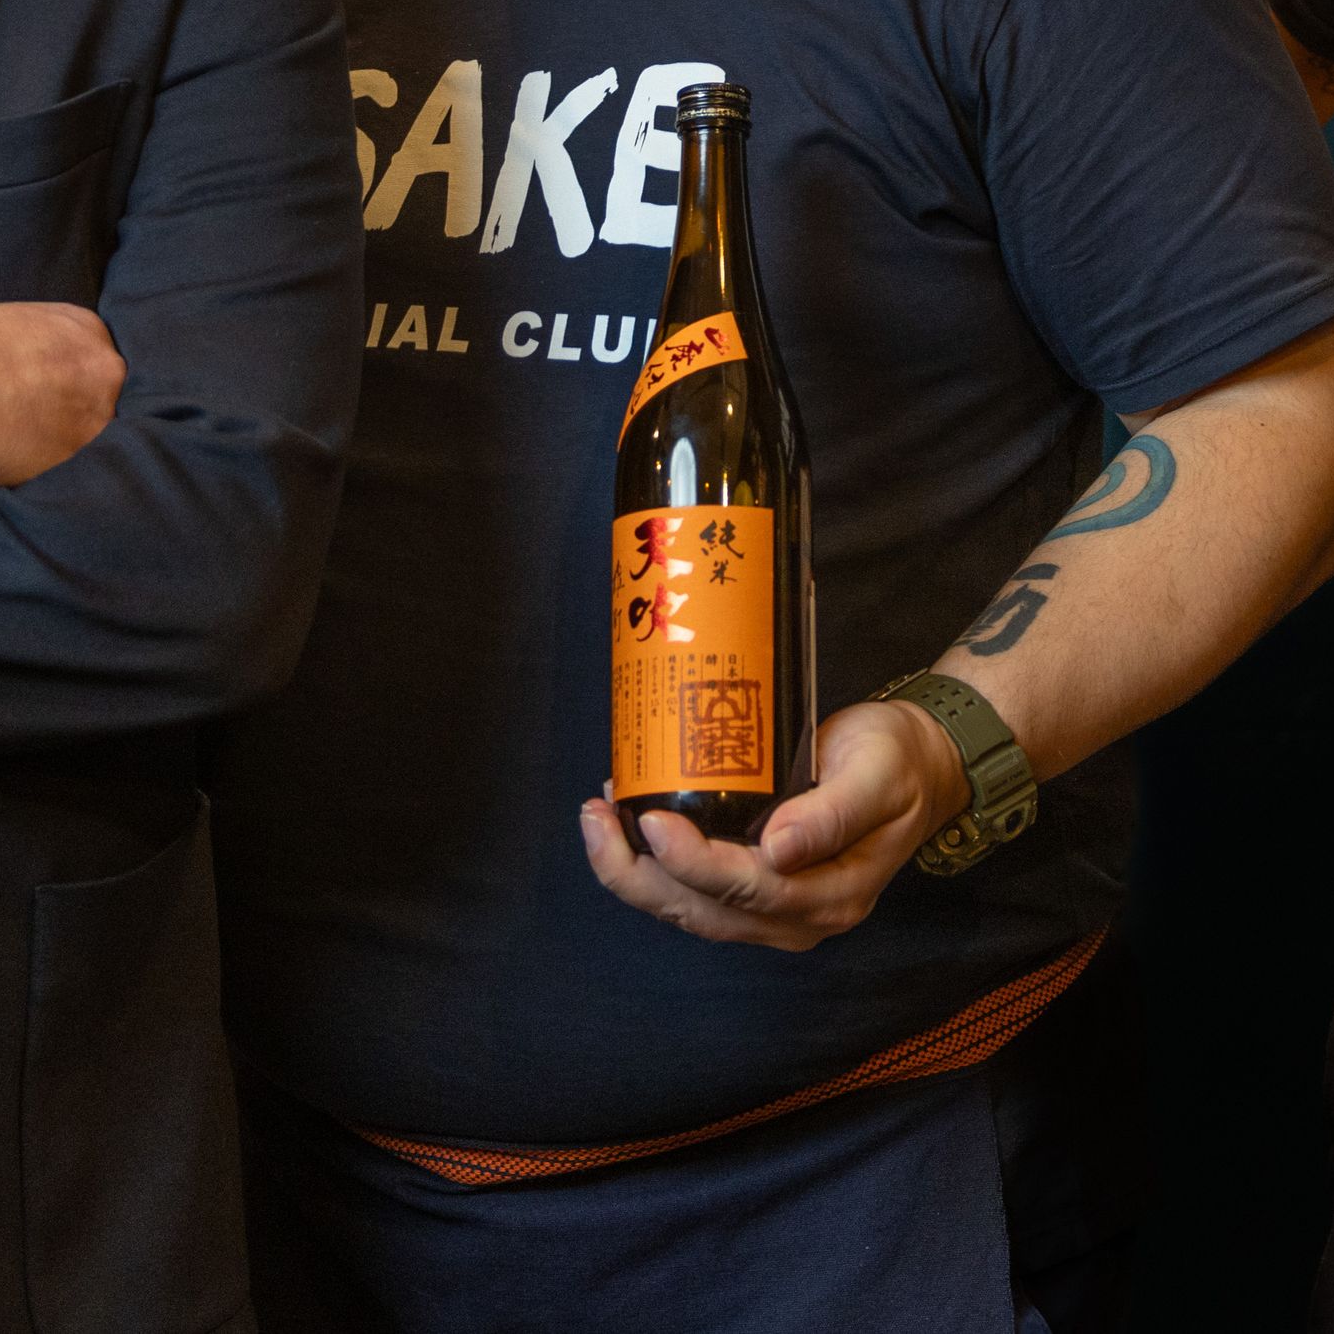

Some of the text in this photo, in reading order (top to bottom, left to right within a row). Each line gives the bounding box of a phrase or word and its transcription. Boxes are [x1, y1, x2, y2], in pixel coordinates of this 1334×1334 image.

[366, 303, 657, 365] IAL CLU
[699, 519, 746, 586] 純米
